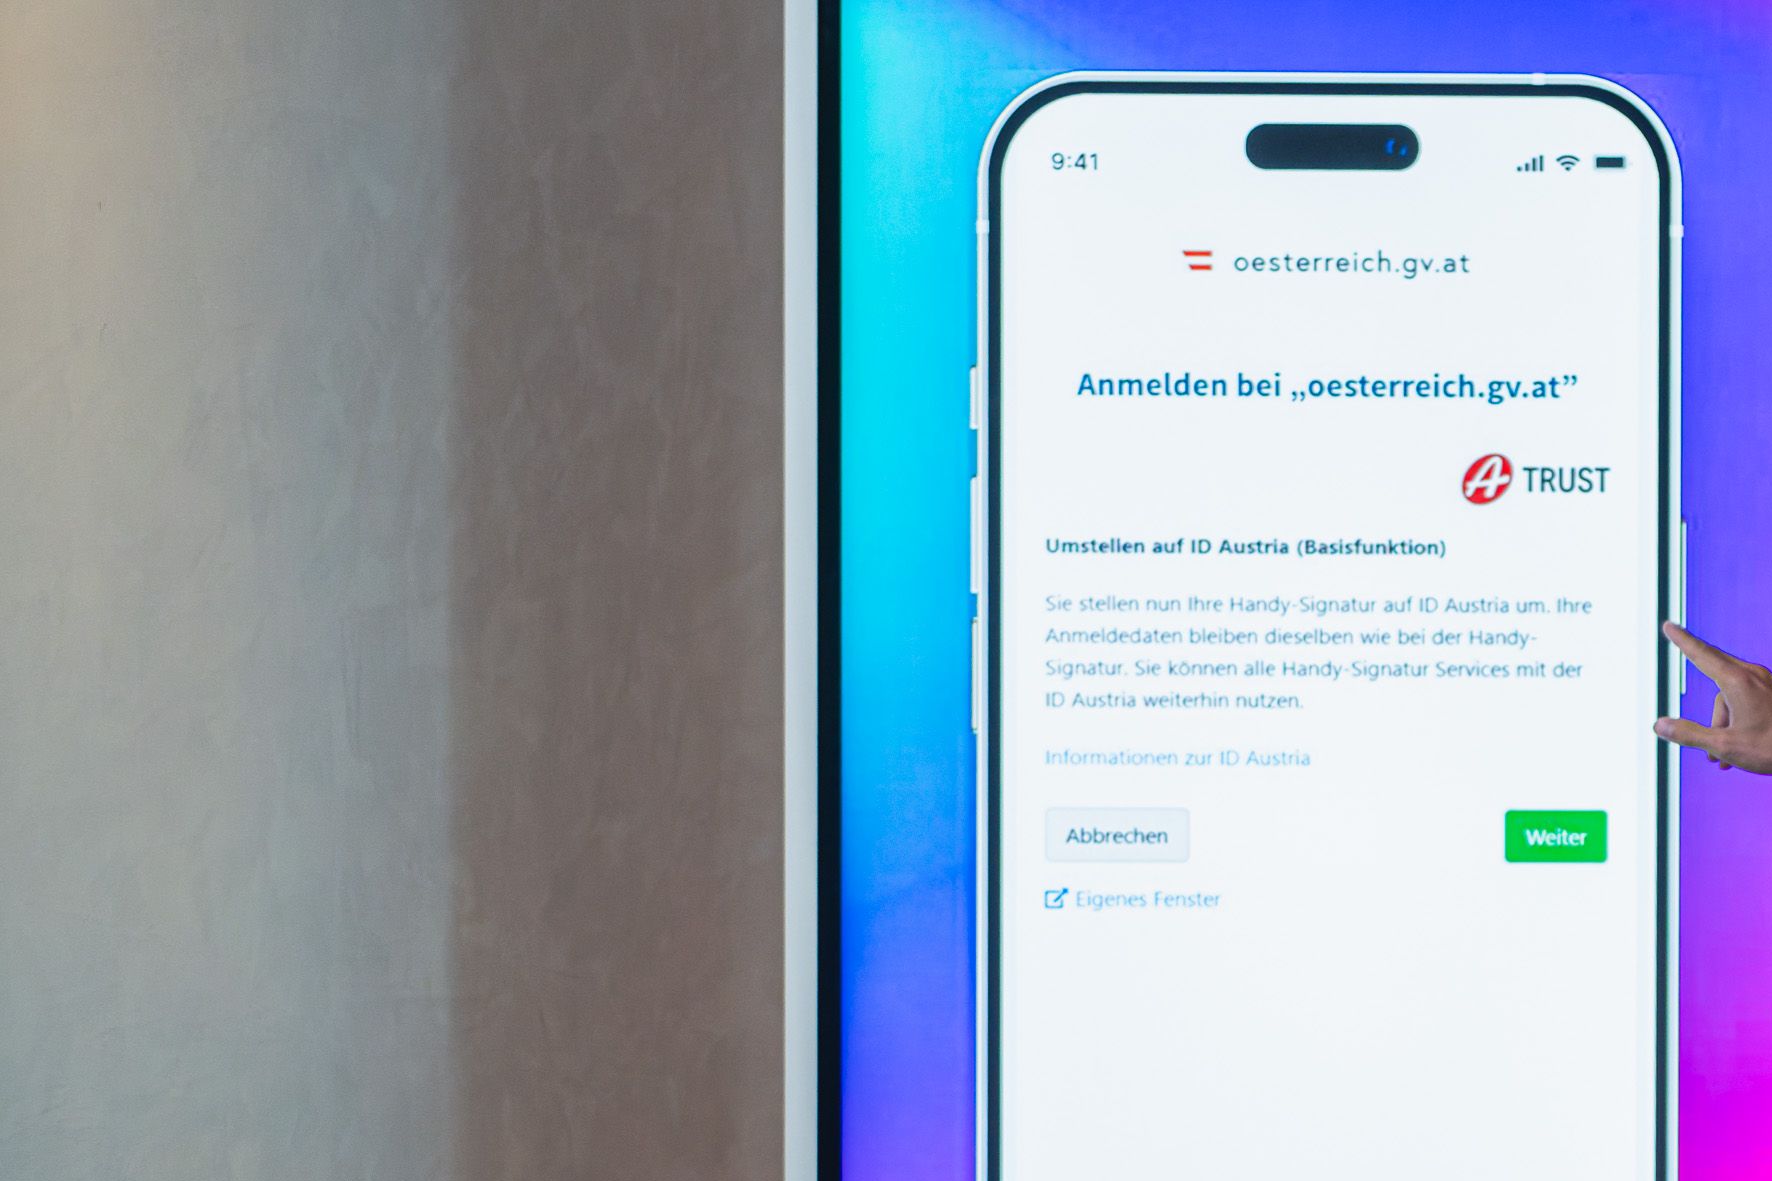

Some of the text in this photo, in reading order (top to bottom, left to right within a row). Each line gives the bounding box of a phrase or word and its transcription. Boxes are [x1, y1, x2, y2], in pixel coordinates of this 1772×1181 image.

[1050, 152, 1099, 172] 9:41
[1232, 248, 1471, 280] oesterreich.gv.at
[1076, 371, 1228, 399] Anmelden
[1236, 372, 1282, 399] bei
[1522, 465, 1612, 494] TRUST
[1045, 537, 1447, 560] Umstellen auf ID Austria (Basisfunktion)
[1045, 596, 1593, 618] Sie stellen nun Ihre Handy-Signatur auf ID Austria um. Ihre
[1045, 628, 1538, 651] Anmeldedaten bleiben dieselben wie bei der Handy-
[1045, 660, 1583, 682] Signatur. Sie können alle Handy-Signatur Services mit der
[1045, 692, 1304, 710] ID Austria weiterhin nutzen.
[1045, 750, 1311, 767] Informationen zur ID Austria
[1065, 827, 1168, 845] Abbrechen
[1524, 828, 1588, 847] Weiter
[1076, 890, 1221, 912] Eigenes Fenster
